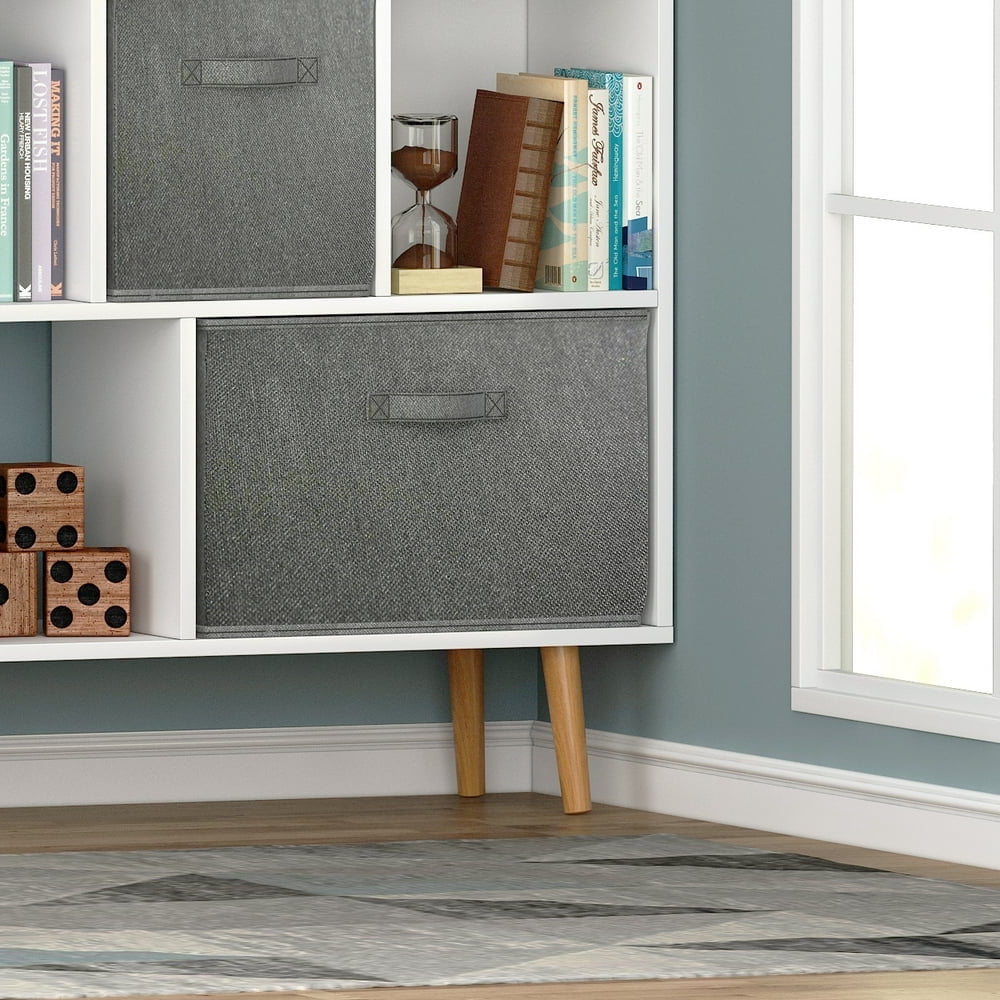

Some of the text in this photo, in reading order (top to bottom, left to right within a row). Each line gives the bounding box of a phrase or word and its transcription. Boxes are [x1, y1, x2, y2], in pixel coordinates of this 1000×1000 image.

[32, 69, 49, 173] LOST FISH
[51, 80, 61, 156] MAKING IT
[588, 93, 606, 187] James Fairfax
[0, 133, 10, 237] Gardens in France
[612, 143, 620, 182] Hemingway
[635, 200, 643, 217] Sea
